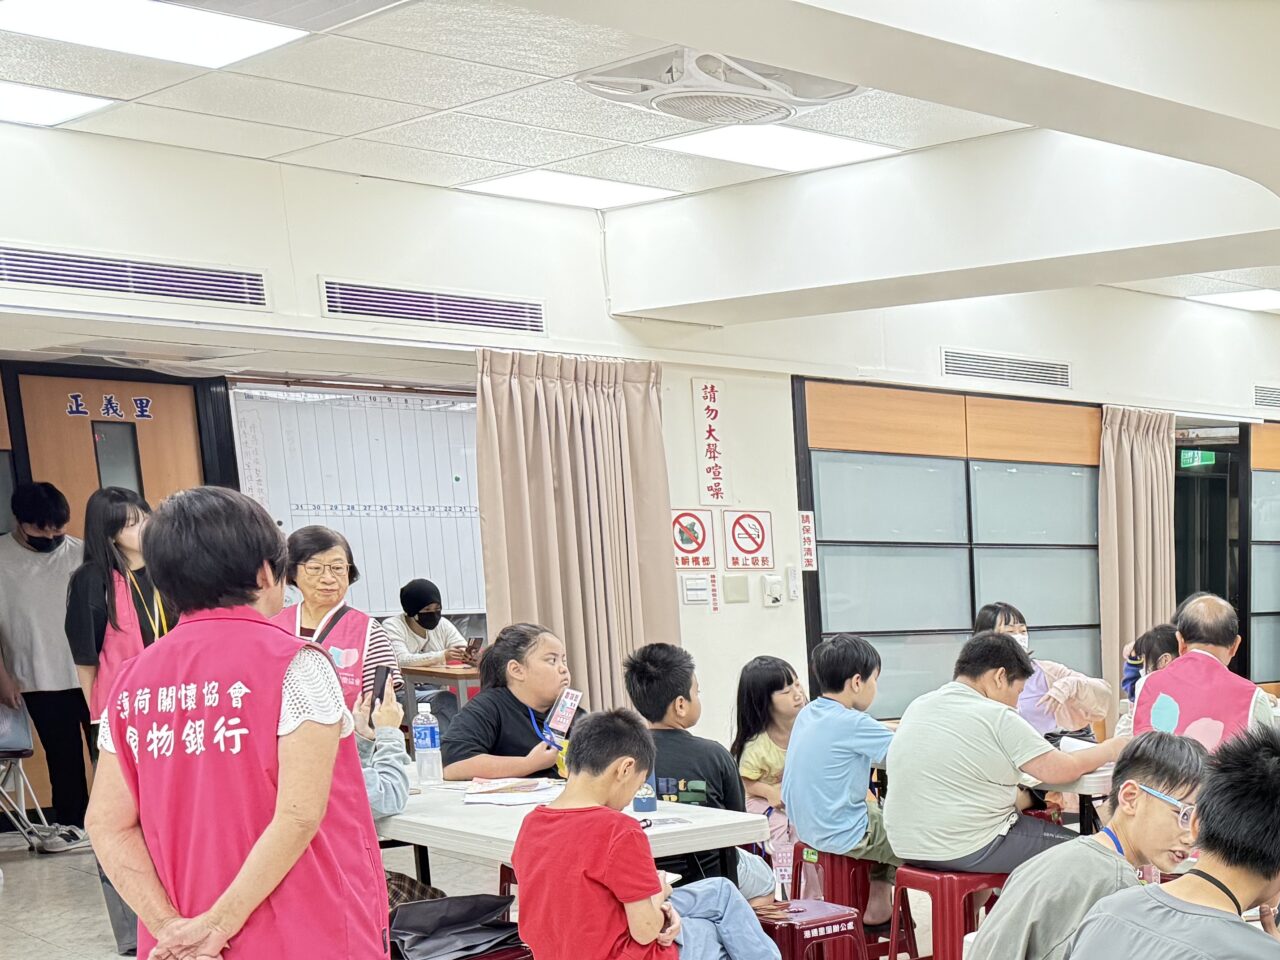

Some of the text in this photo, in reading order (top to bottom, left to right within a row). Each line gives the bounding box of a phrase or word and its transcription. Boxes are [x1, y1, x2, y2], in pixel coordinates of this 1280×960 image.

[66, 393, 153, 419] 正義里
[701, 384, 724, 500] 請勿大聲喧噪
